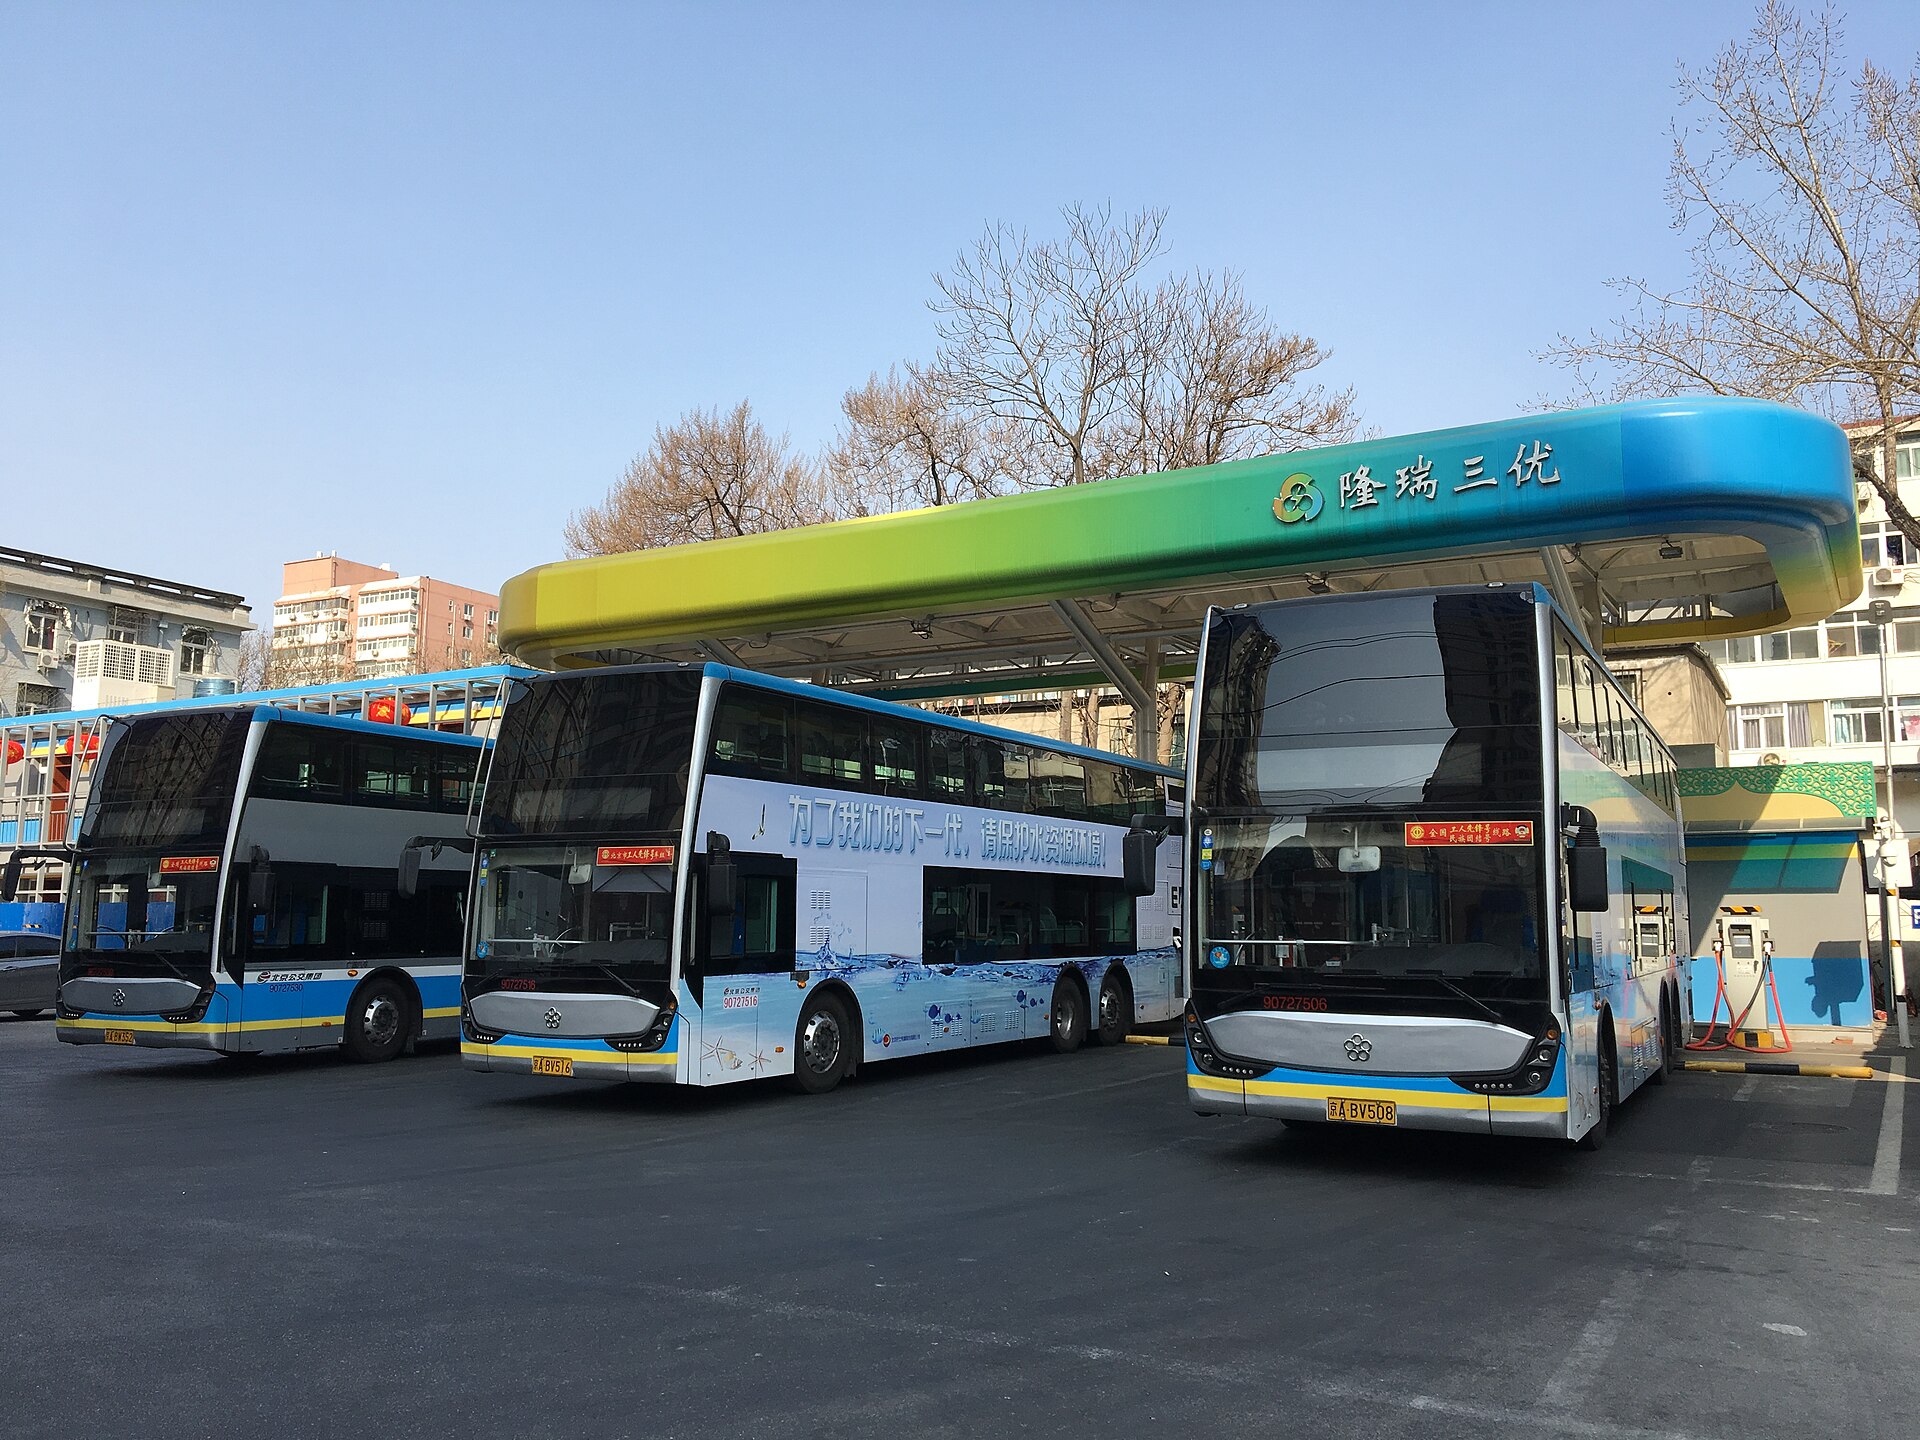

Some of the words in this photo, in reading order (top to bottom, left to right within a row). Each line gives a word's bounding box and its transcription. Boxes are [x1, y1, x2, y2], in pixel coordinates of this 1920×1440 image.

[1339, 439, 1561, 510] 隆瑞三优
[501, 979, 536, 990] 90727516
[723, 995, 758, 1008] 90727516
[1263, 996, 1328, 1011] 90727506
